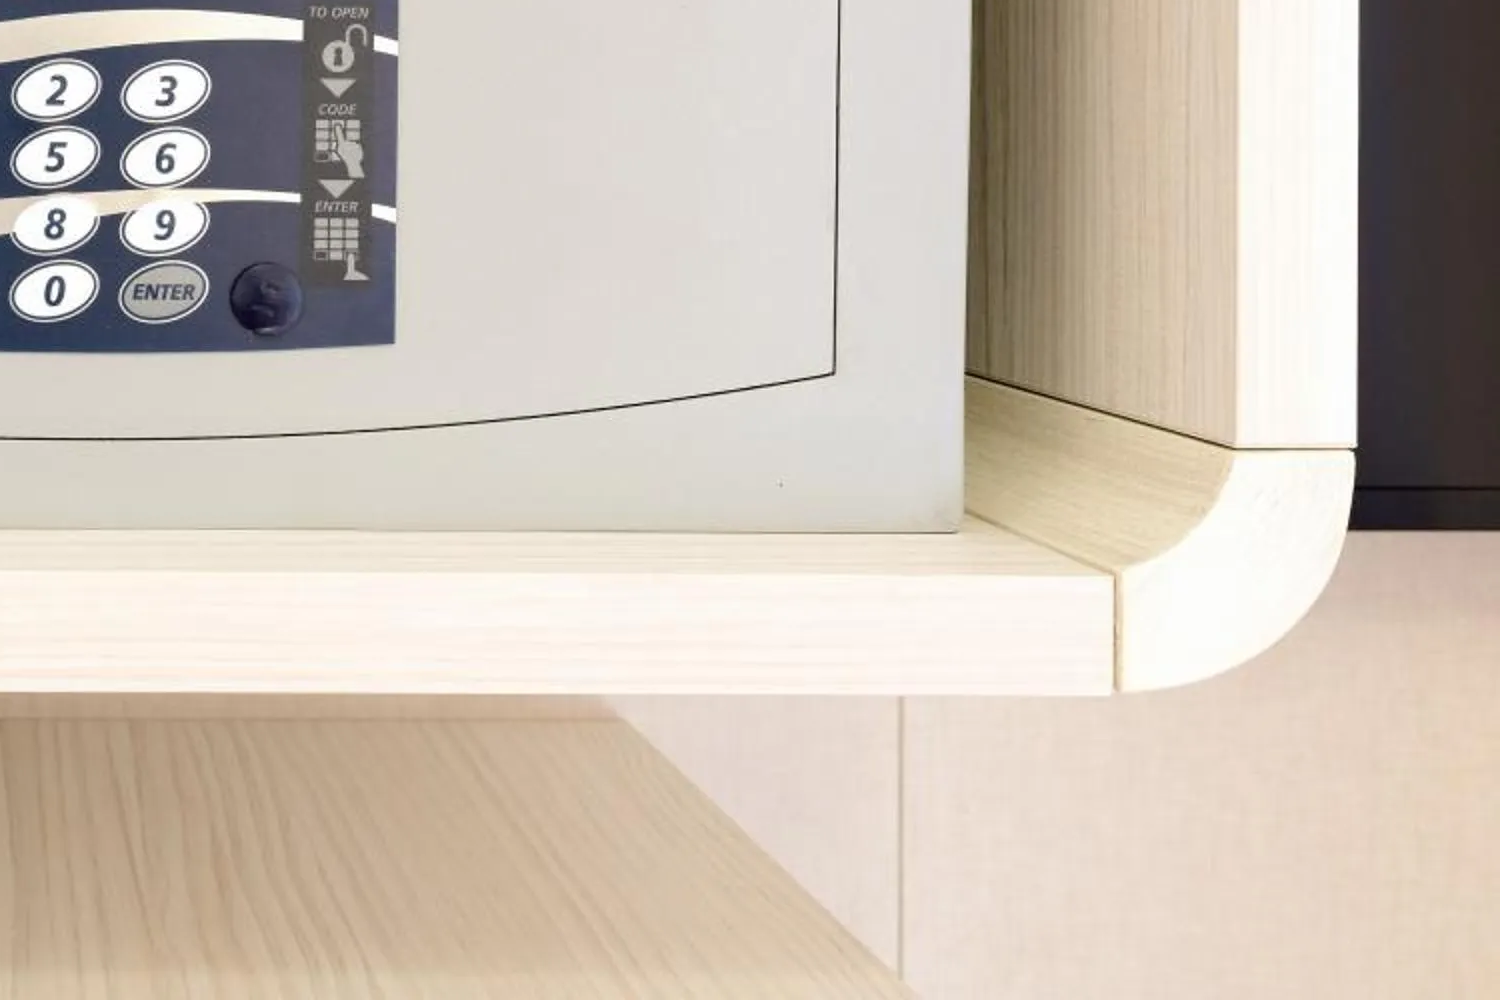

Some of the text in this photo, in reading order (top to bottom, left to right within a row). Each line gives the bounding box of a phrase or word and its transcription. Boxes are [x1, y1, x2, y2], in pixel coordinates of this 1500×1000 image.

[310, 6, 370, 19] TO OPEN
[46, 75, 67, 106] 2
[155, 75, 177, 106] 3
[319, 104, 357, 116] CODE
[44, 141, 67, 172] 5
[155, 143, 176, 174] 6
[315, 201, 358, 212] ENTER
[44, 209, 66, 240] 8
[154, 210, 175, 240] 9
[44, 276, 66, 307] 0
[132, 283, 195, 301] ENTER
